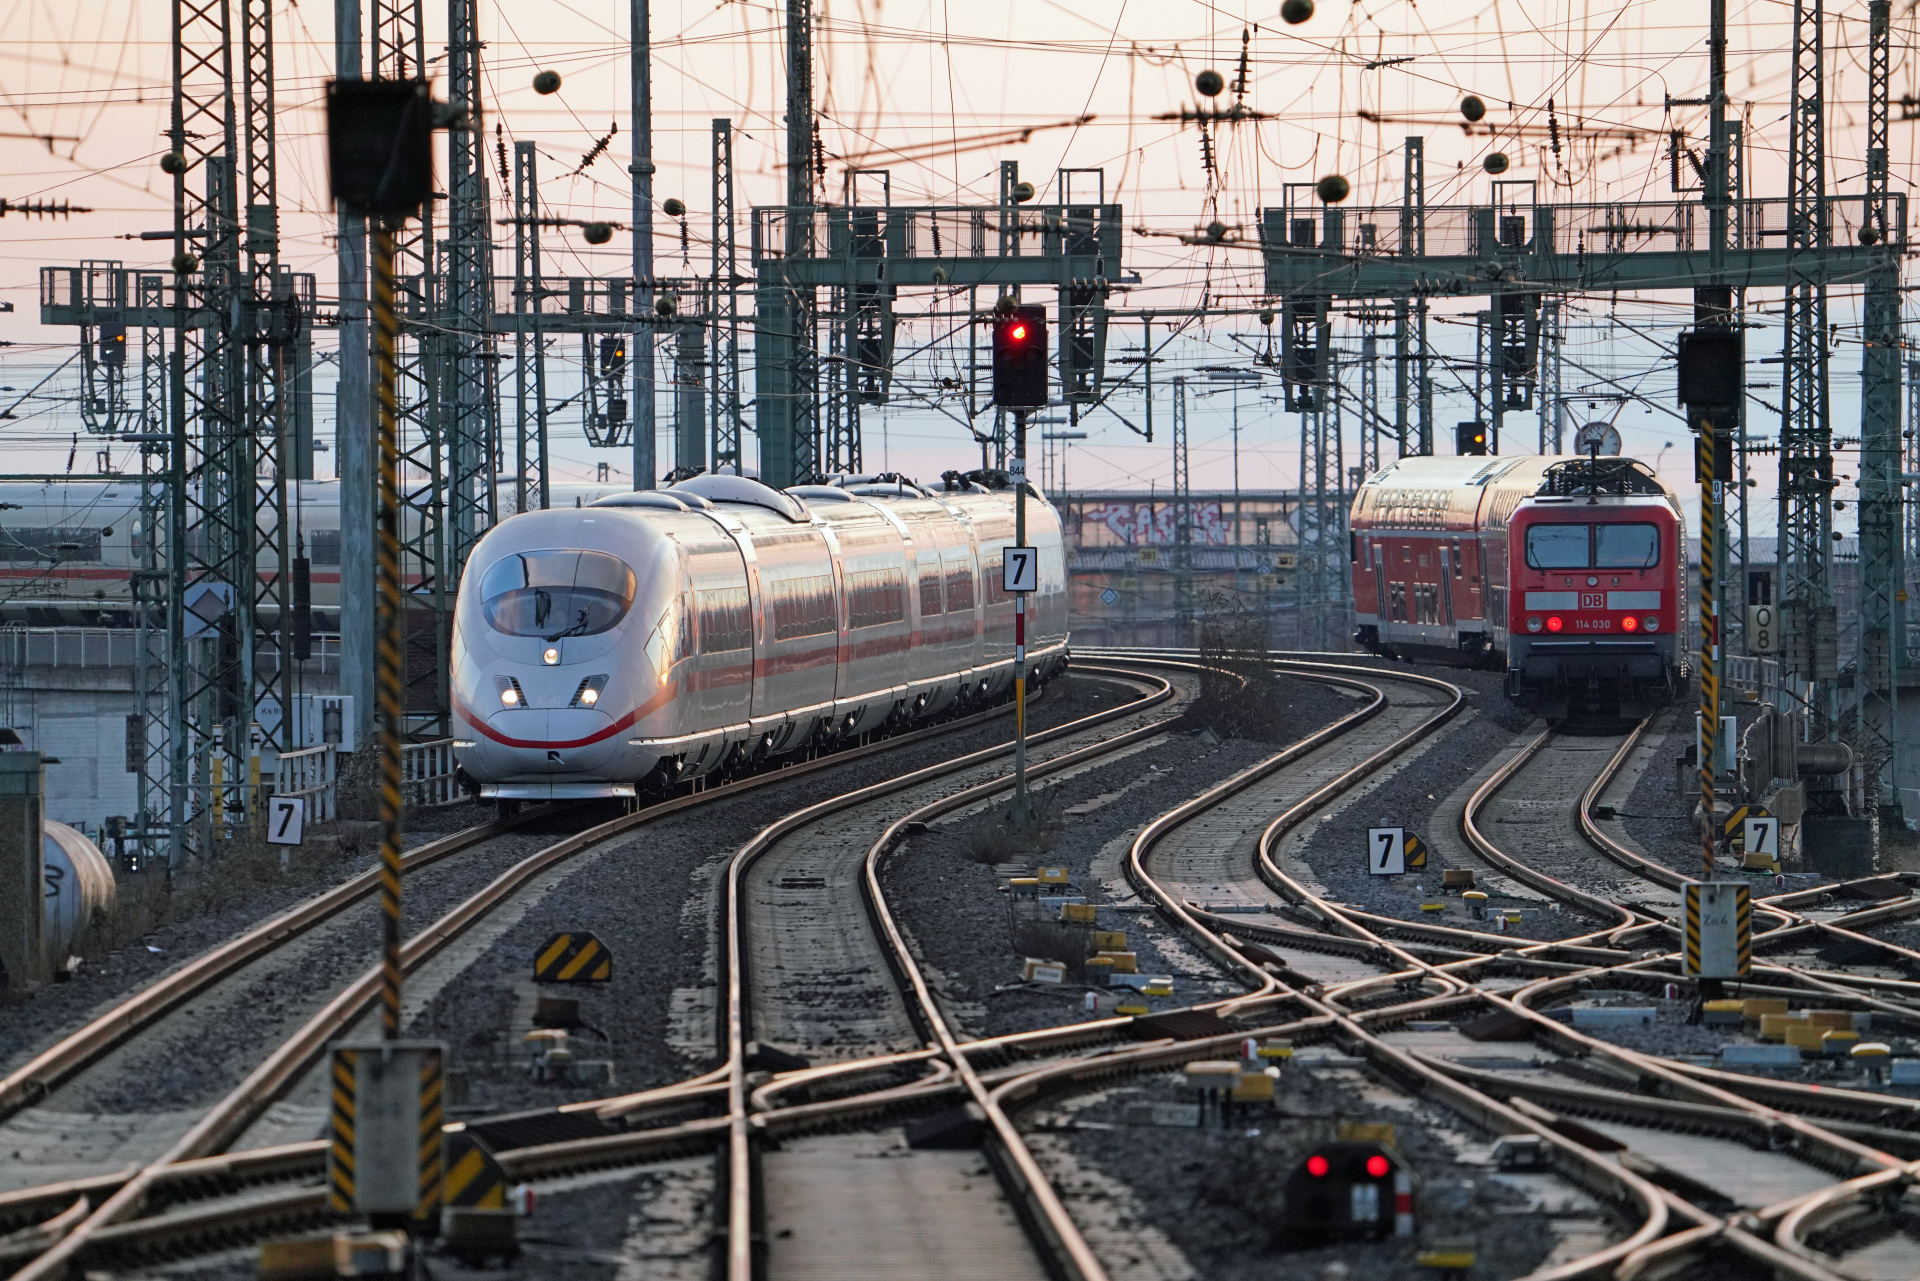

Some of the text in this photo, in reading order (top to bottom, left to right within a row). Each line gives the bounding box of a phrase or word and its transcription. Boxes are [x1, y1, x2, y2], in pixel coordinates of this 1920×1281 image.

[1009, 466, 1025, 476] 844
[1141, 551, 1156, 560] 381
[1013, 554, 1027, 585] 7
[1582, 594, 1603, 607] DB
[1576, 620, 1611, 629] 114 030
[1758, 629, 1770, 649] 8
[261, 707, 272, 715] Ks
[278, 803, 294, 837] 7
[1753, 823, 1768, 852] 7
[1378, 834, 1394, 868] 7
